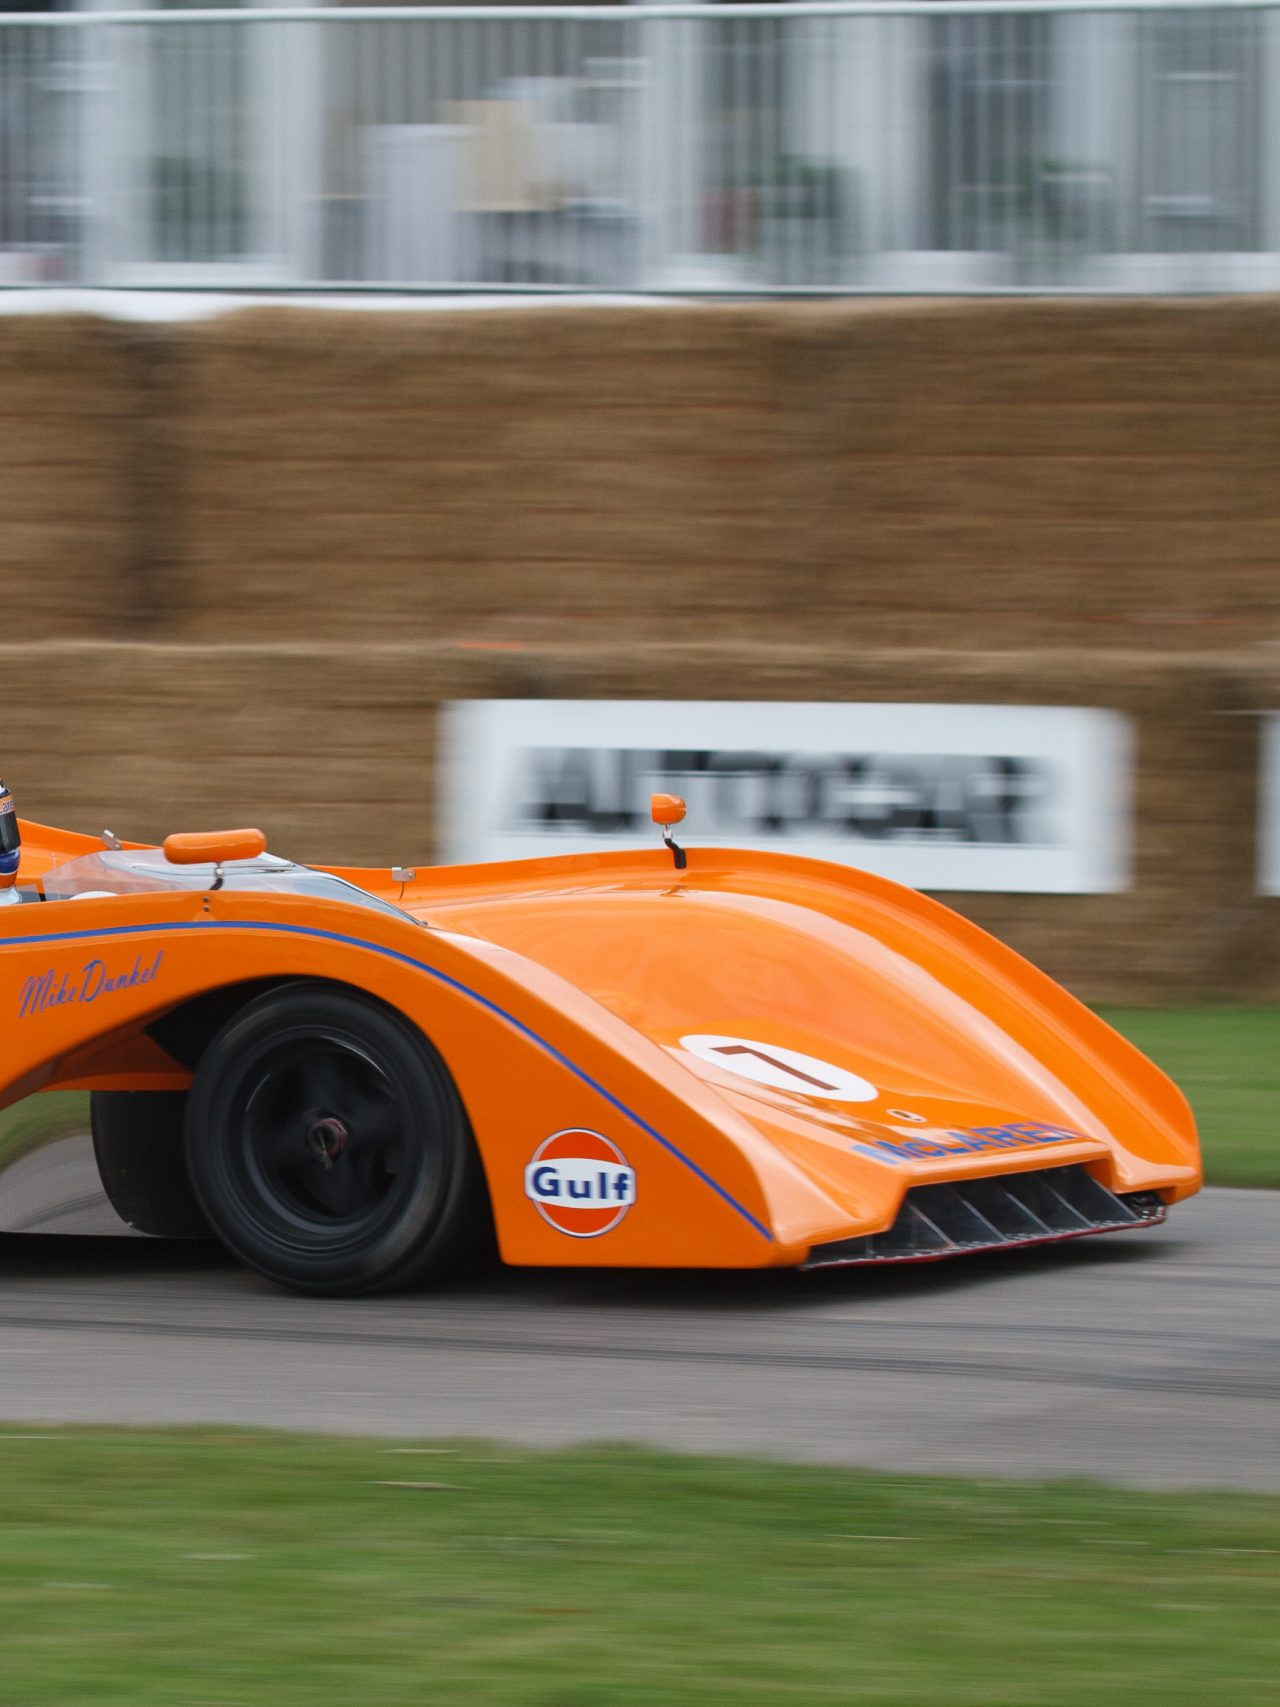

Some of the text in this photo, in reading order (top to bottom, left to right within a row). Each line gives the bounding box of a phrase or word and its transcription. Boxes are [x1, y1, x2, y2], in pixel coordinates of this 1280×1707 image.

[18, 949, 165, 1019] Mike Dunkel
[532, 1166, 631, 1201] Gulf
